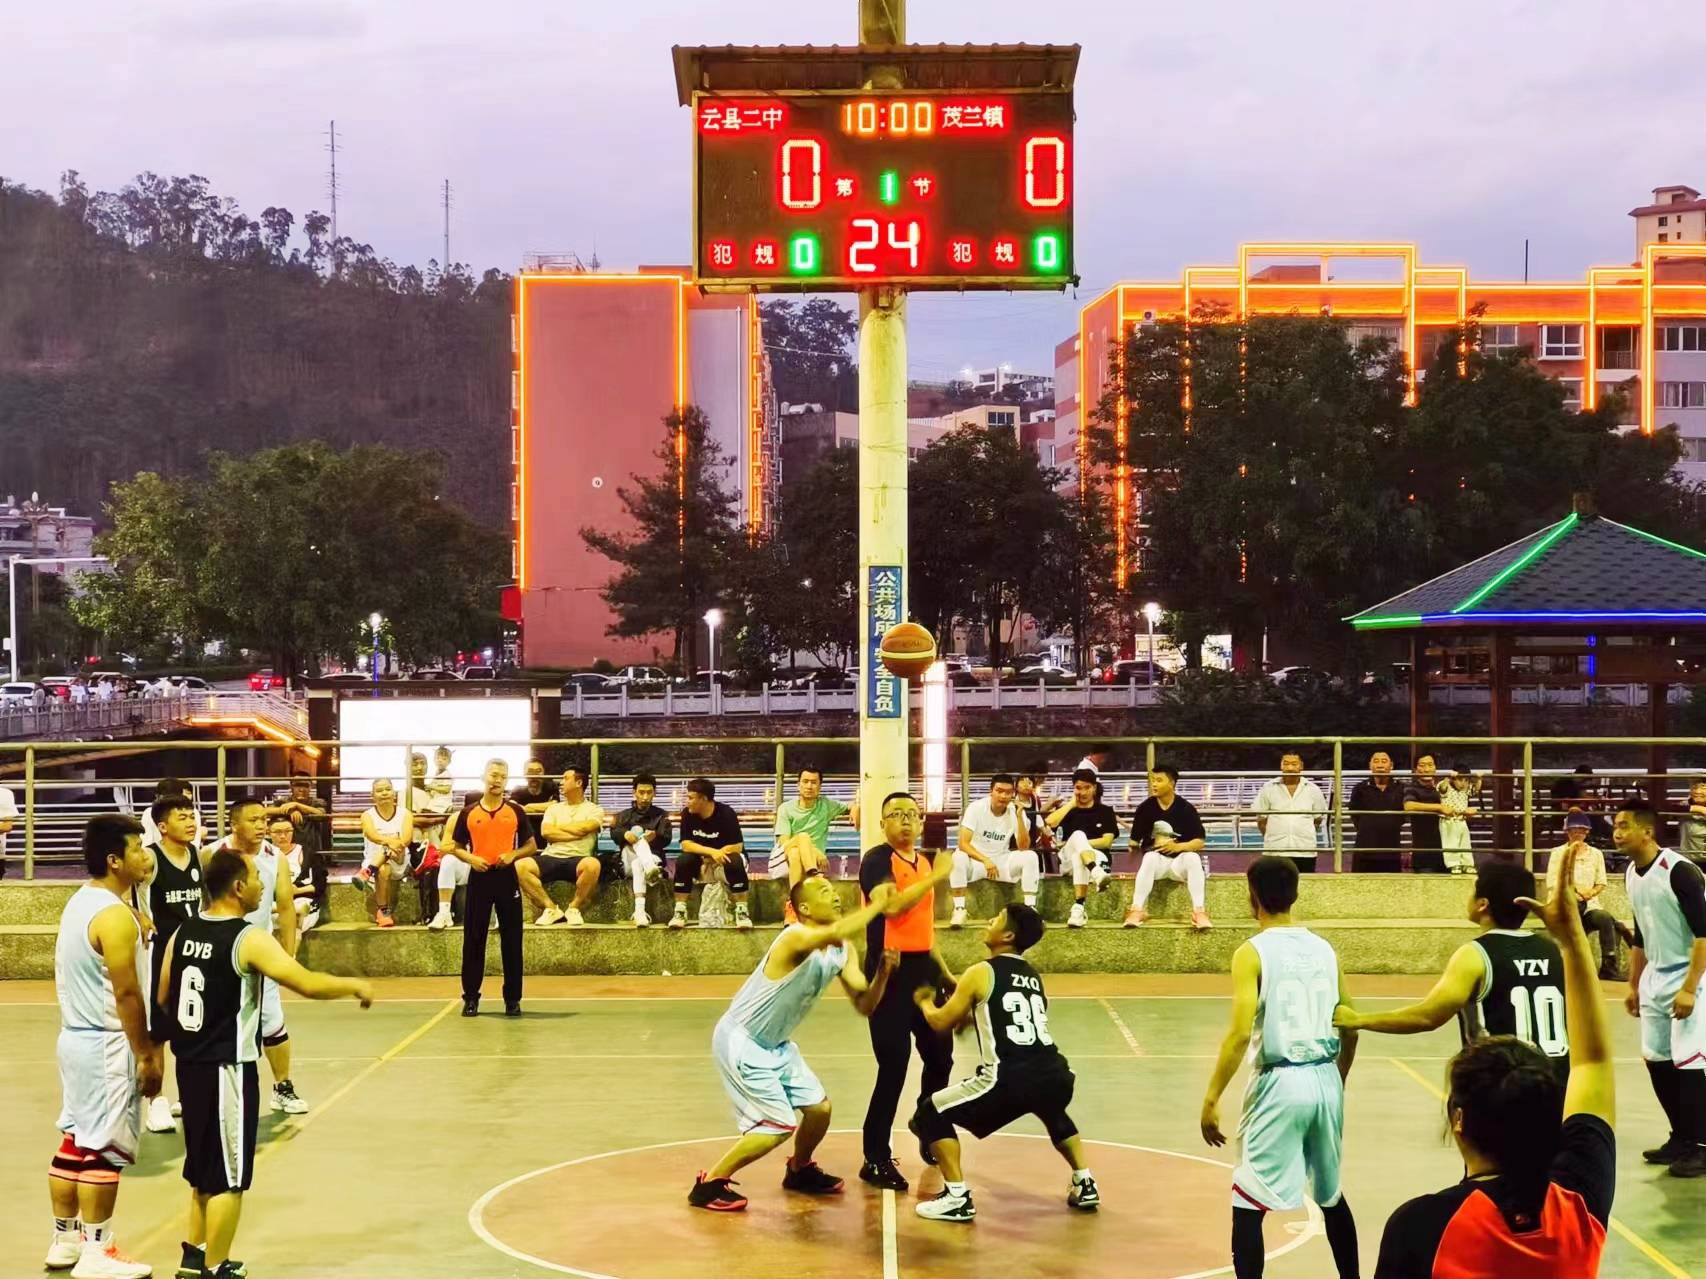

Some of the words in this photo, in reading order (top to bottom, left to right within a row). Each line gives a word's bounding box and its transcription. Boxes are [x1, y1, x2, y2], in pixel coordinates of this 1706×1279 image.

[701, 107, 783, 130] 云县二中
[845, 102, 932, 133] 10:00
[941, 104, 1004, 128] 茂兰镇
[782, 139, 821, 209] 0
[1025, 137, 1065, 207] 0
[794, 238, 814, 270] 0
[849, 219, 920, 272] 24
[1037, 236, 1058, 268] 0
[873, 571, 897, 713] 公共场所全自负
[182, 939, 213, 960] DYB
[1010, 973, 1041, 992] ZXQ
[1512, 958, 1550, 977] YZY
[178, 965, 206, 1032] 6
[1276, 977, 1334, 1041] 30
[1510, 985, 1570, 1058] 10
